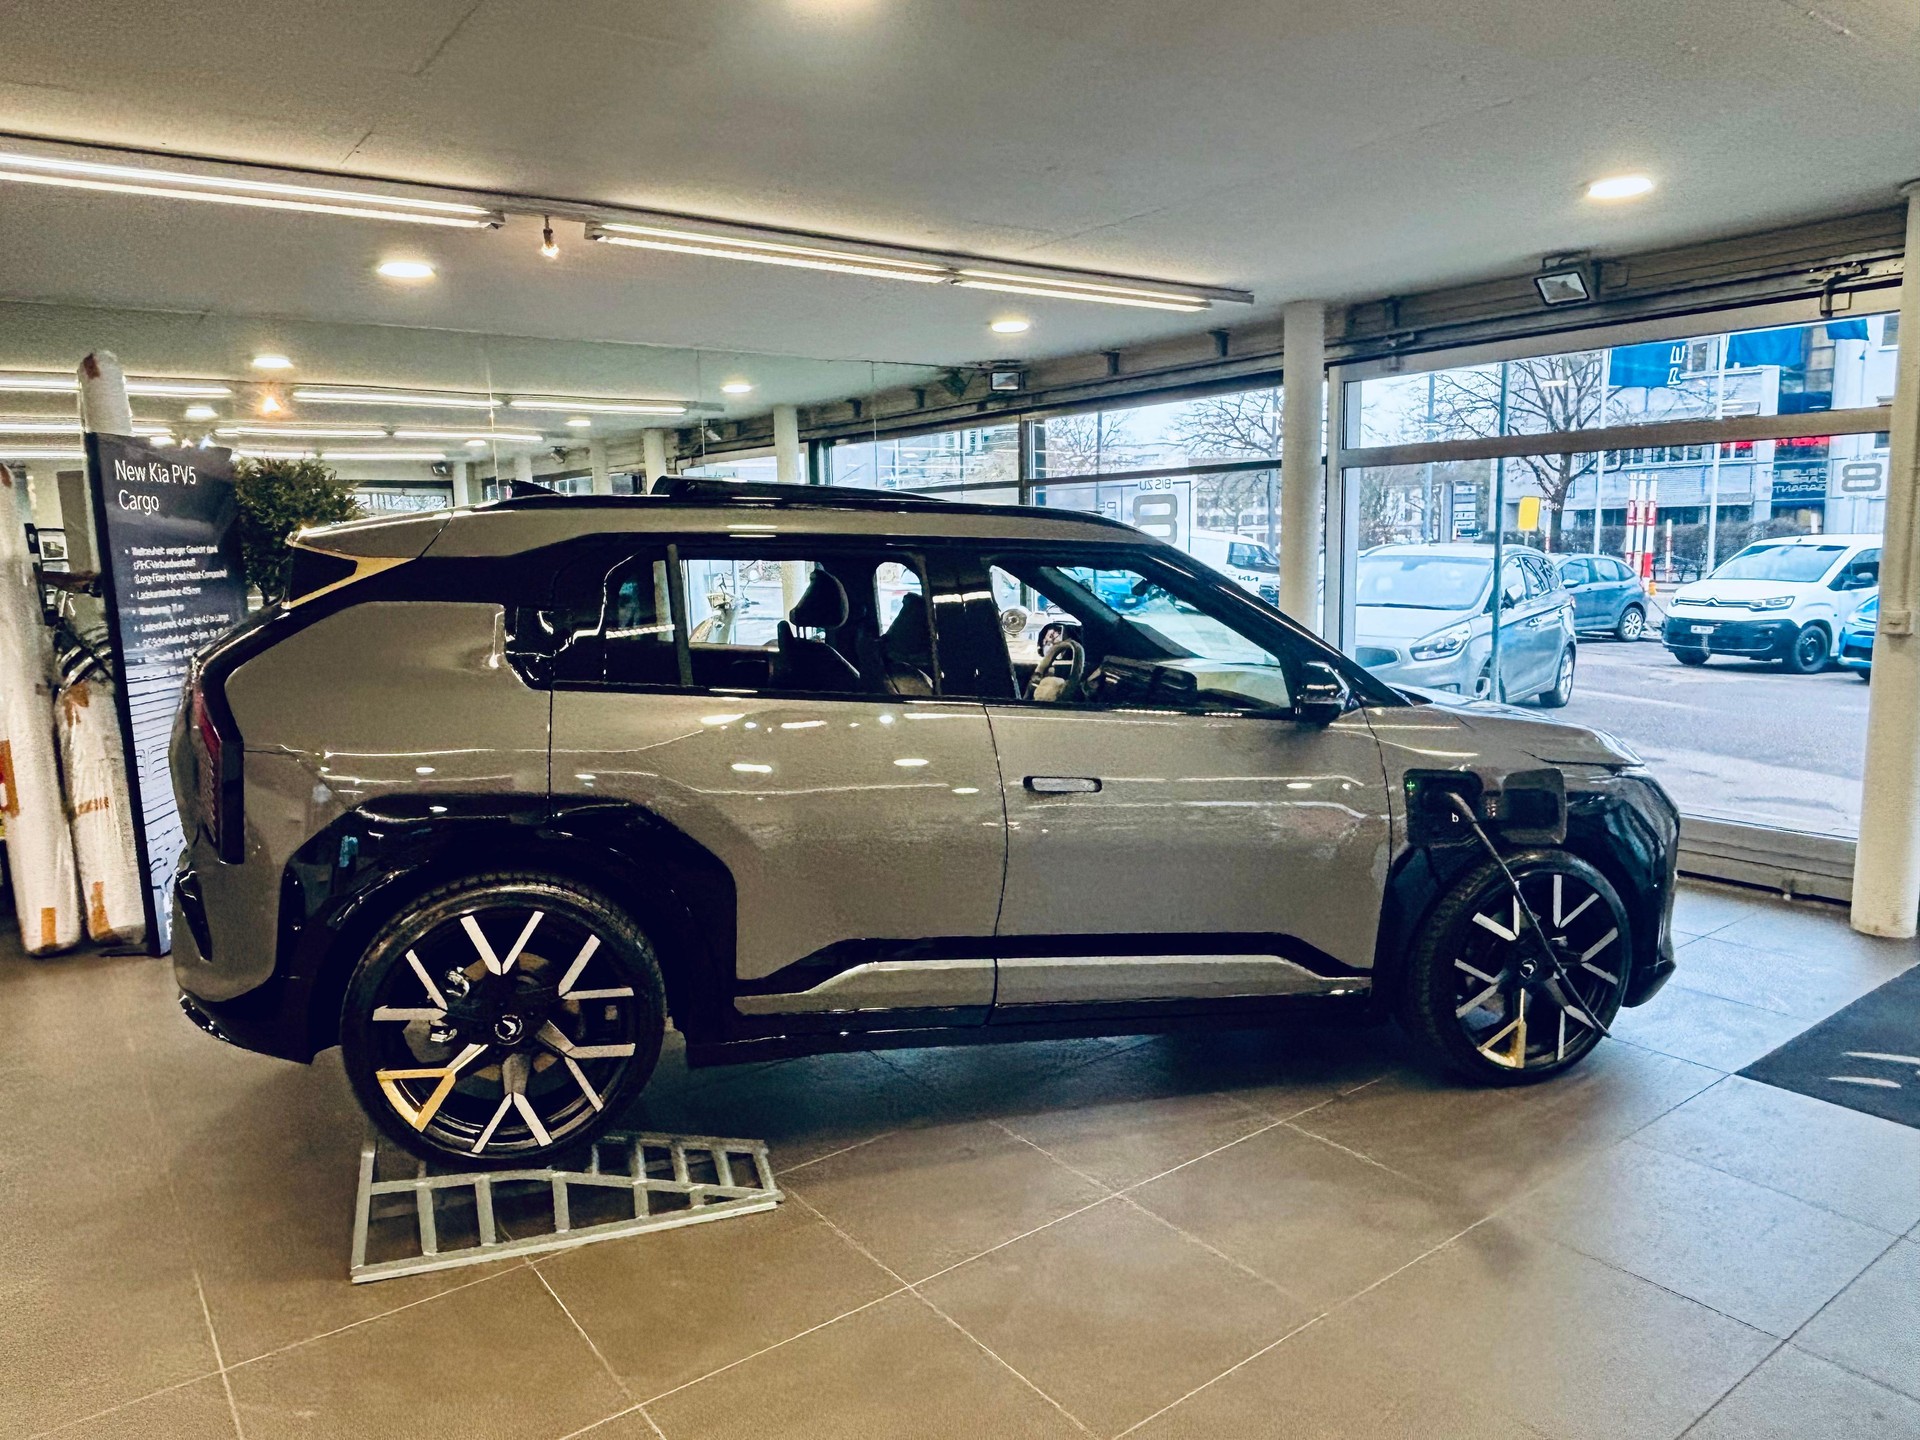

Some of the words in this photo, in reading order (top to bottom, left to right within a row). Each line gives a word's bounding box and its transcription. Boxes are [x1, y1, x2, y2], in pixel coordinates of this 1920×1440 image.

[114, 459, 146, 481] New
[148, 462, 170, 482] Kia
[171, 464, 197, 485] PV5
[118, 489, 160, 516] Cargo
